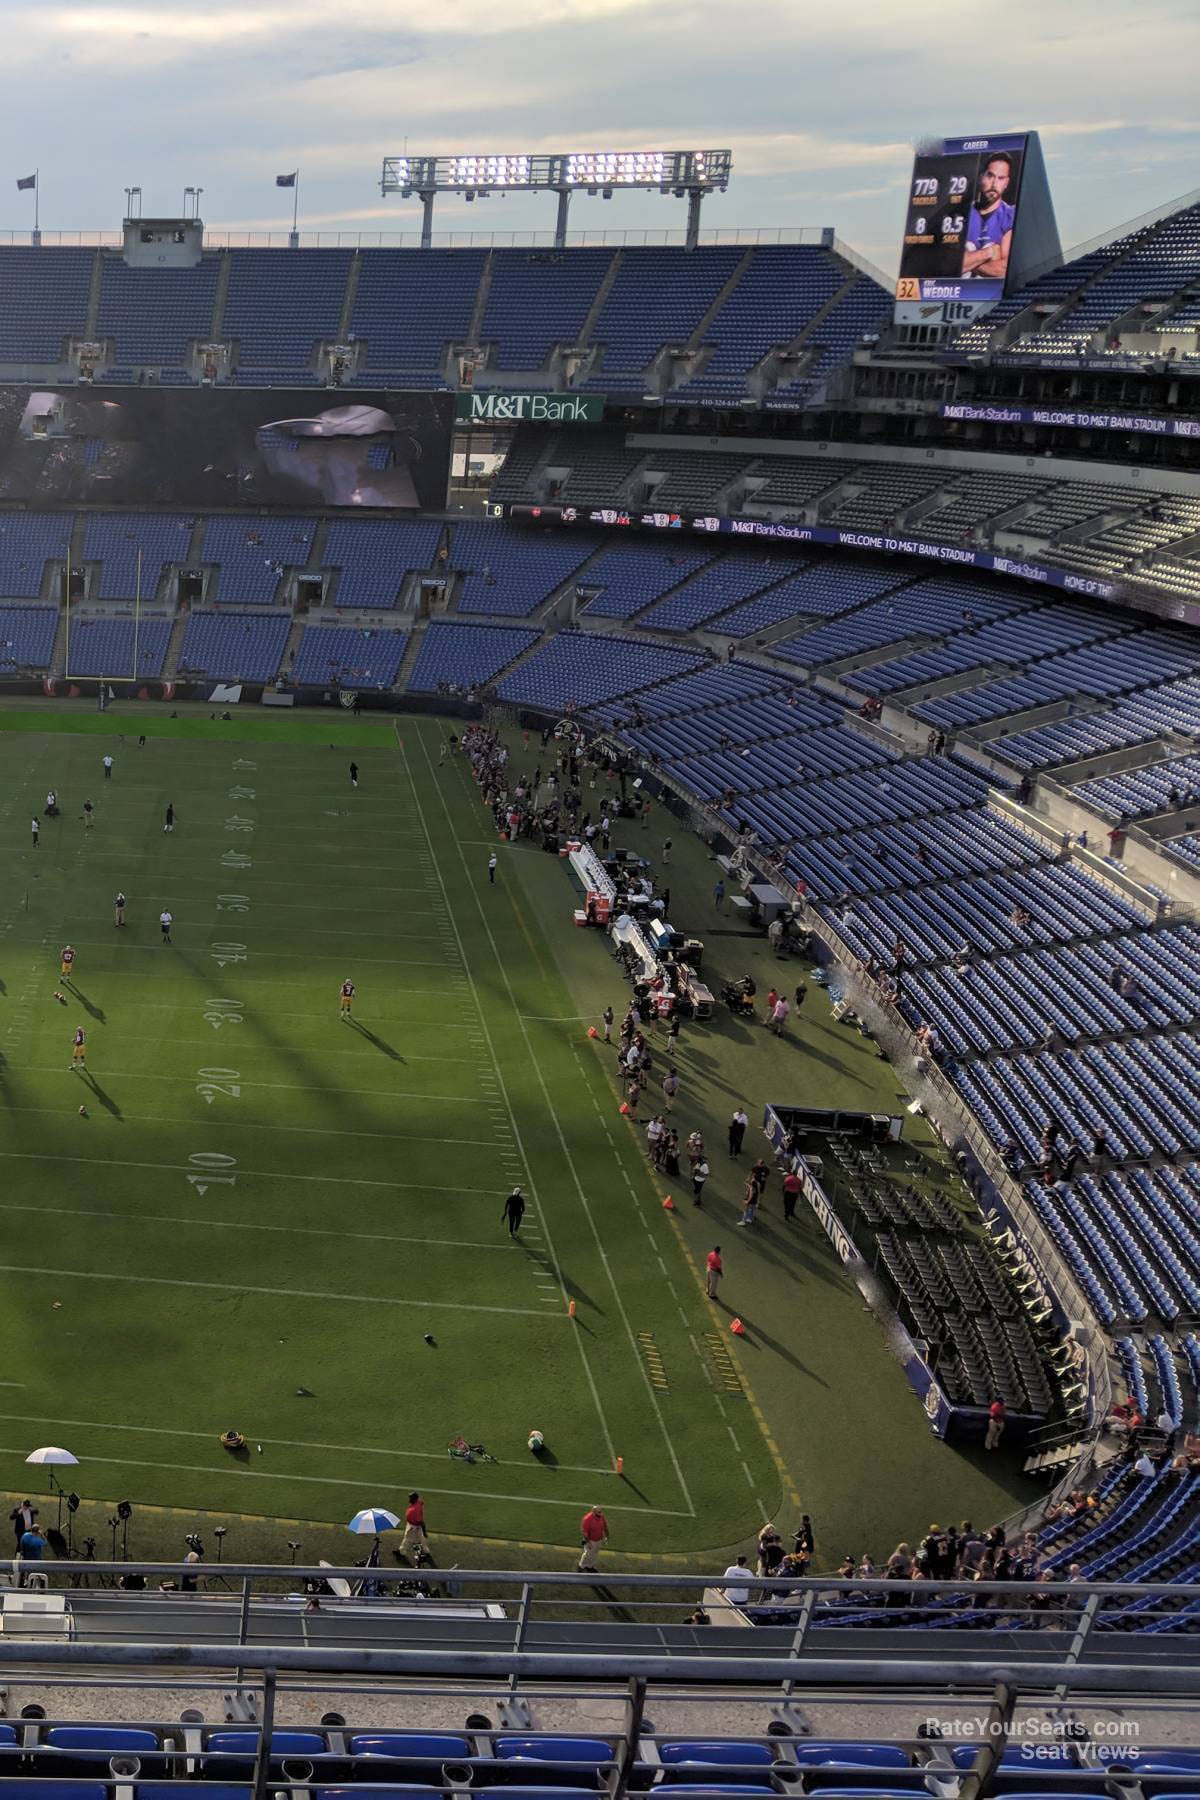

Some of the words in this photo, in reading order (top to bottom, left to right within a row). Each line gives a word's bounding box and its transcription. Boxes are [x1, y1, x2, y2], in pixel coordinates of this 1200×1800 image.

[963, 140, 989, 150] CAREER
[913, 178, 938, 196] 779
[949, 176, 968, 194] 29
[915, 217, 926, 234] 8
[942, 216, 964, 233] 8.5
[899, 281, 914, 298] 32
[922, 286, 961, 299] WEDDLE
[942, 302, 973, 323] Lite
[470, 394, 530, 419] M&T
[532, 396, 588, 420] Bank
[944, 405, 964, 418] M&T
[965, 408, 986, 420] Bank
[986, 408, 1021, 422] Stadium
[1032, 411, 1075, 425] WELCOME
[1077, 414, 1090, 425] TO
[1090, 415, 1109, 427] M&T
[1111, 416, 1133, 429] BANK
[1133, 418, 1167, 432] STADIUM
[494, 505, 501, 516] 0
[732, 520, 756, 534] M&T
[756, 523, 777, 536] Bank
[777, 525, 812, 540] Stadium
[839, 532, 883, 548] WELCOME
[885, 538, 898, 550] TO
[898, 540, 918, 552] M&T
[919, 543, 940, 557] BANK
[940, 547, 975, 563] STADIUM
[1064, 575, 1086, 591] HOME
[1086, 580, 1097, 593] OF
[216, 894, 250, 912] 50
[210, 942, 248, 962] 40
[202, 999, 245, 1023] 30
[195, 1067, 241, 1098] 20
[186, 1152, 238, 1186] 10
